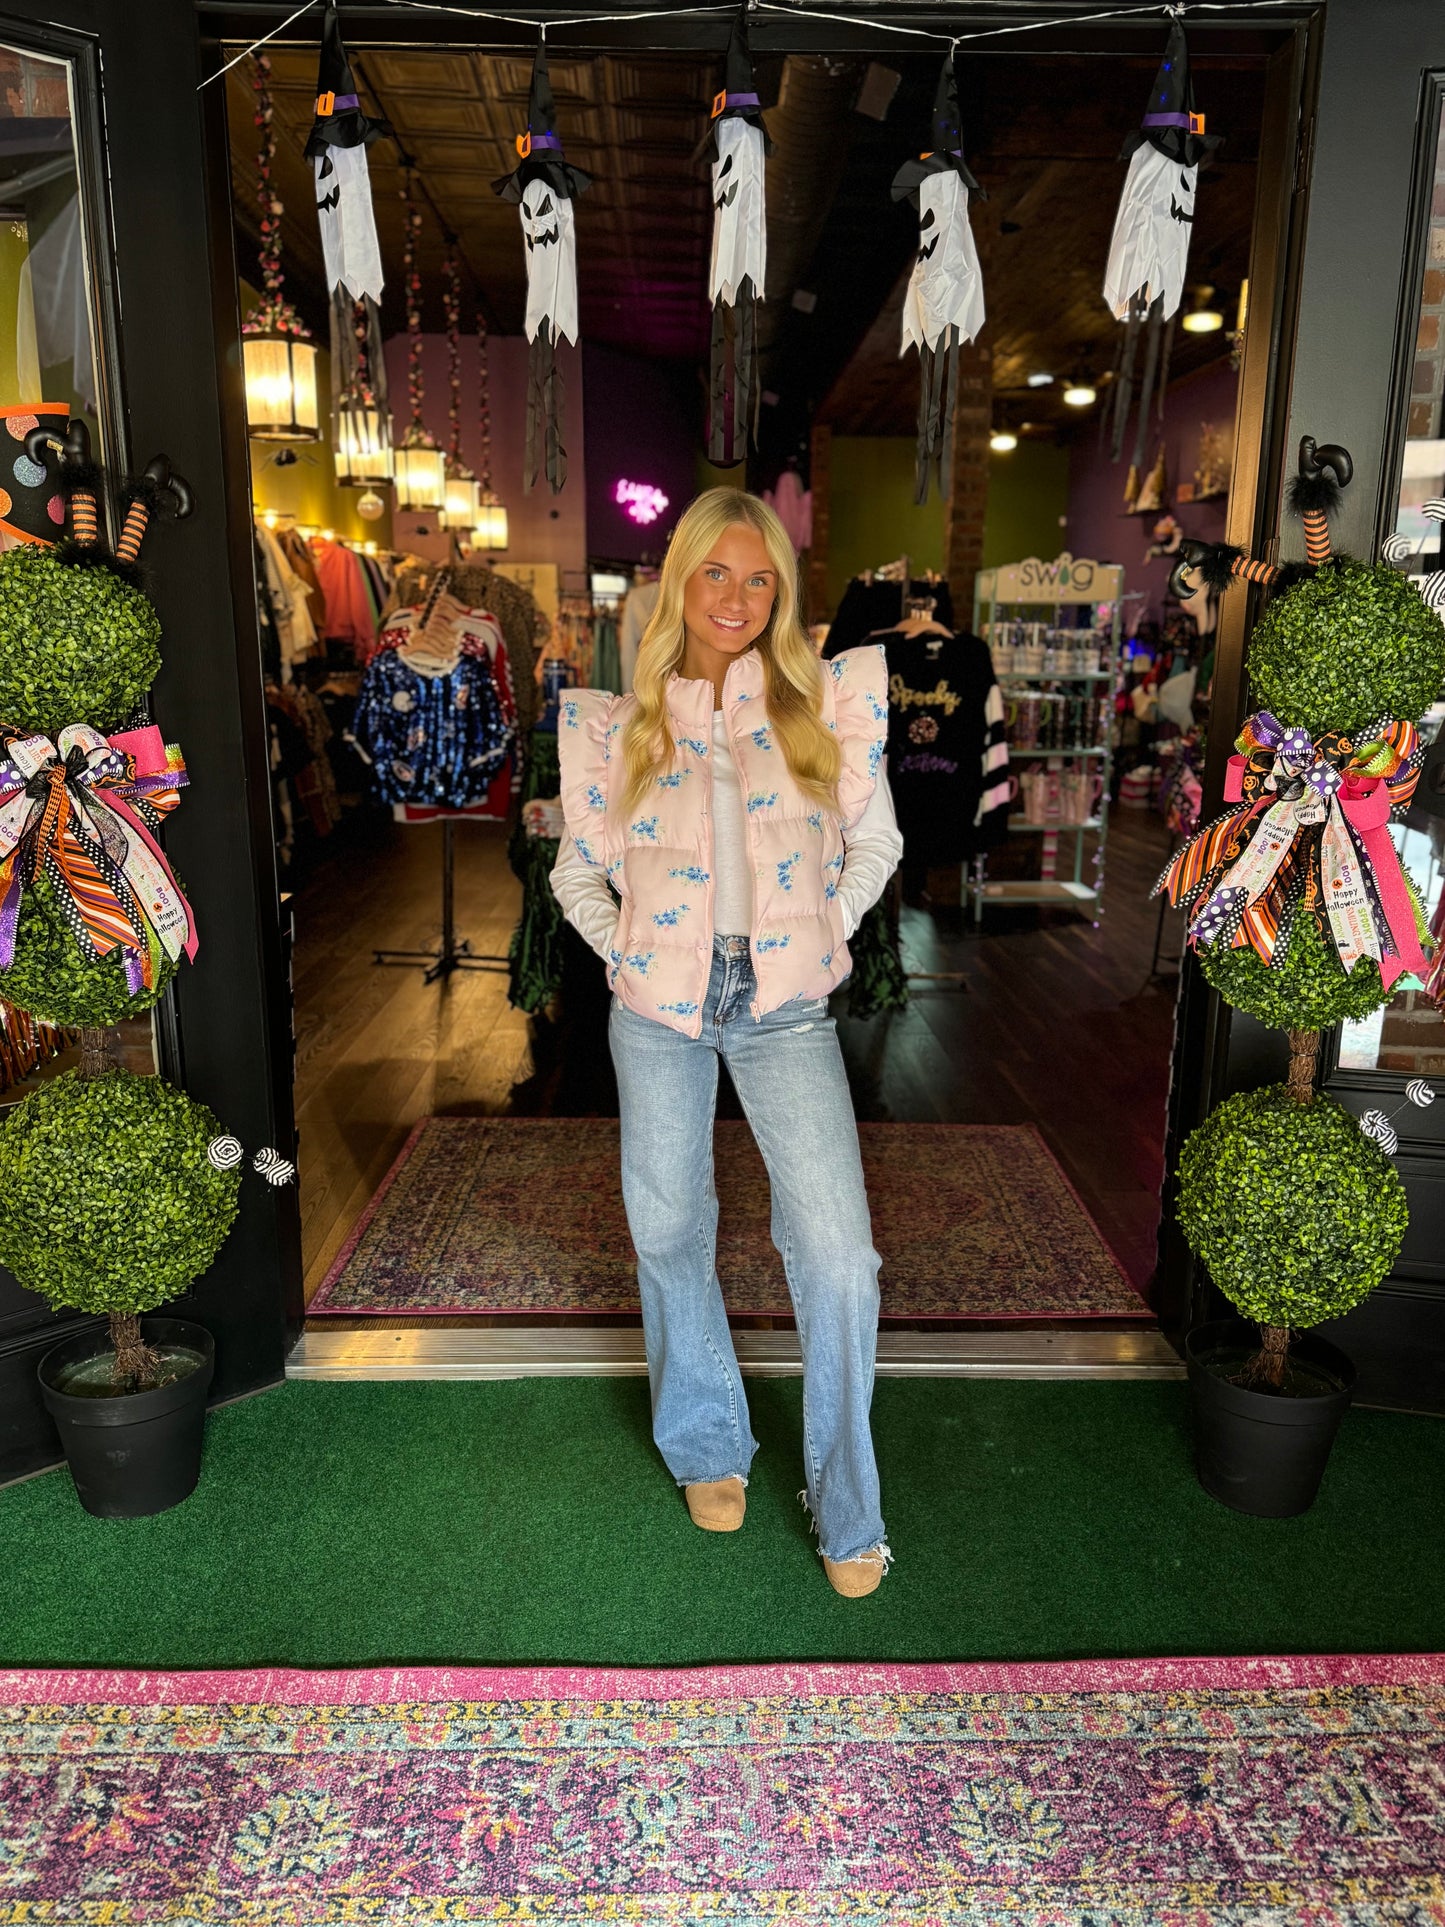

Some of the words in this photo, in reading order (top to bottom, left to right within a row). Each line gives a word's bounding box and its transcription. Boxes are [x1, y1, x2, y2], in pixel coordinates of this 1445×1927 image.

[889, 674, 962, 715] Spooky
[1263, 821, 1296, 838] alloween
[1263, 829, 1286, 844] Happy
[1257, 838, 1270, 855] BOO!
[1341, 864, 1353, 887] BOO!
[155, 886, 172, 908] BOO!
[1333, 888, 1359, 899] Happy
[156, 906, 179, 922] Happy
[1357, 907, 1373, 941] SPOOKY
